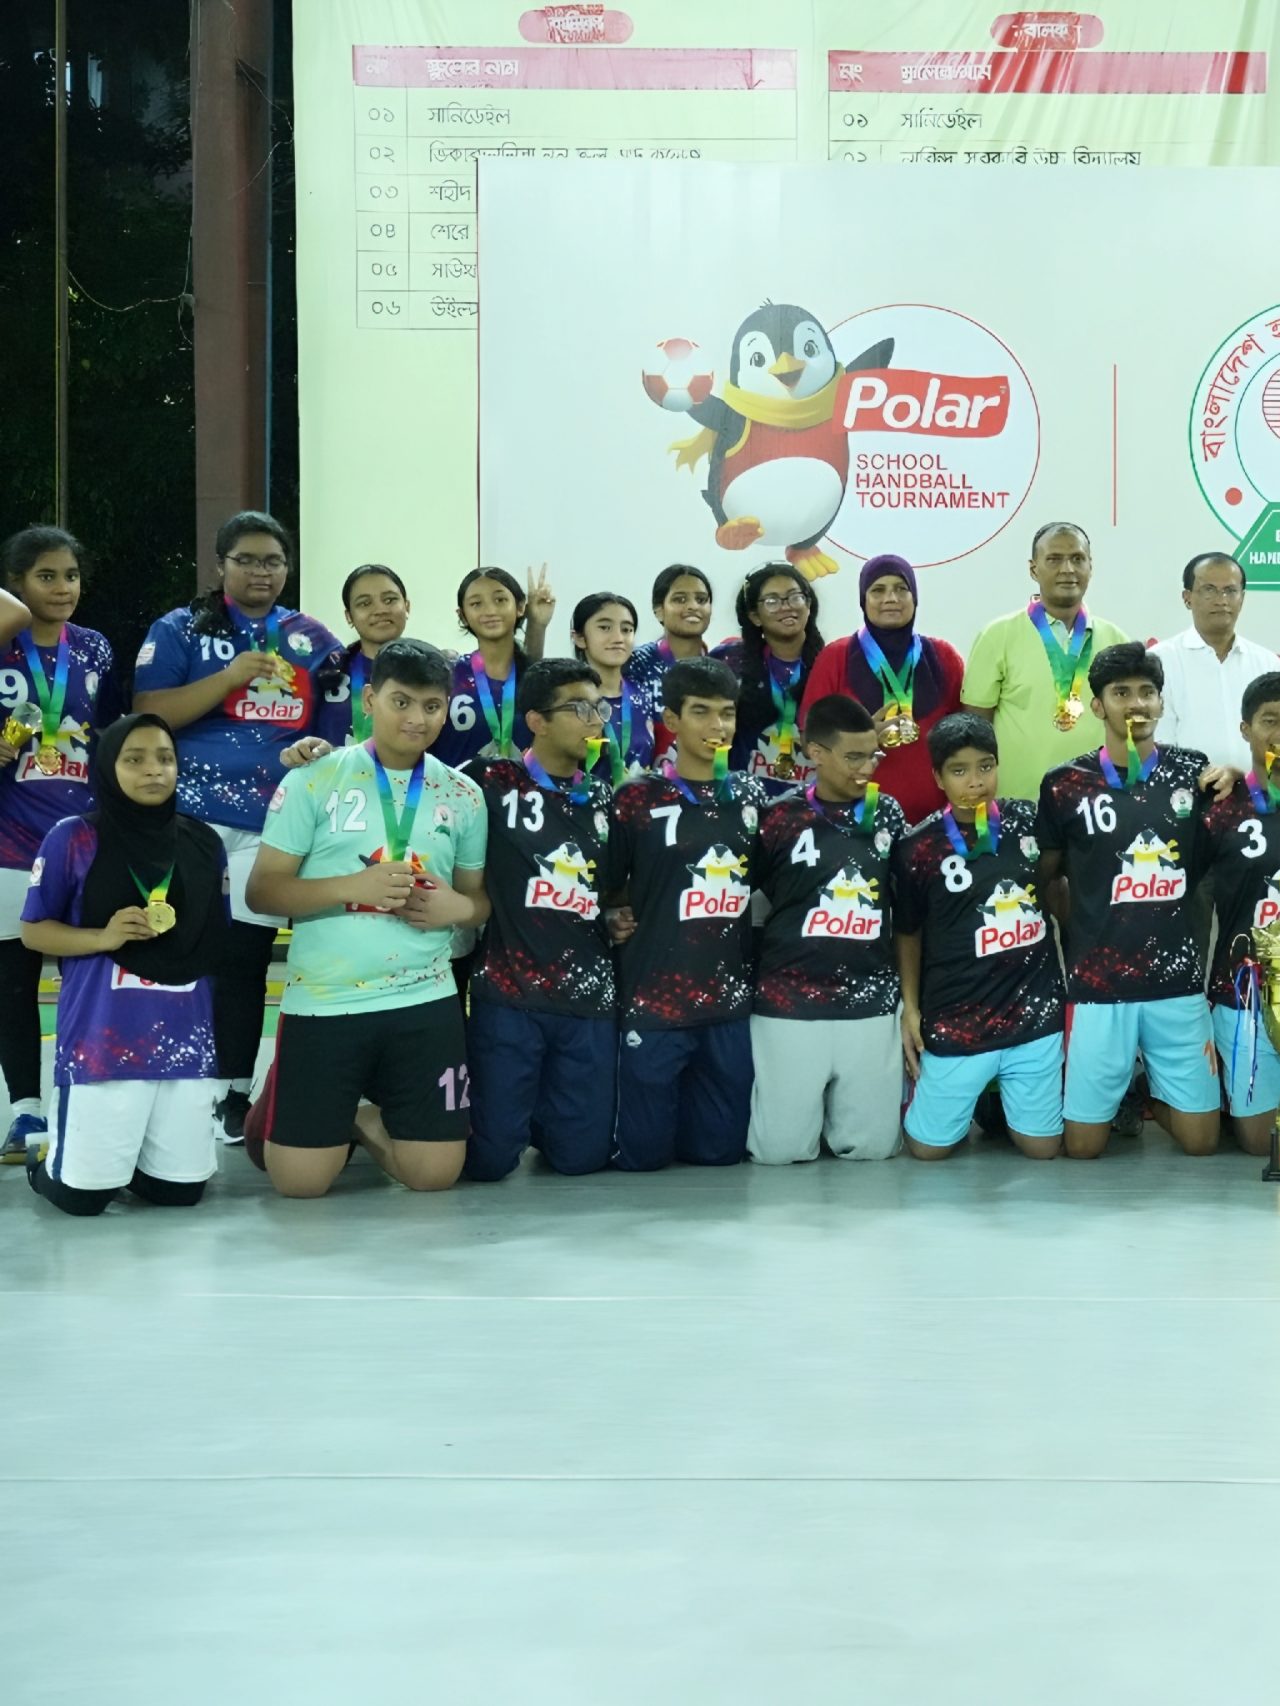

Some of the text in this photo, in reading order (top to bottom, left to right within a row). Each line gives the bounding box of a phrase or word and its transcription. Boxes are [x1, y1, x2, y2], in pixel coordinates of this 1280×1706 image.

[843, 376, 1001, 429] Polar
[1200, 334, 1266, 463] বাংলাদেশ
[855, 473, 973, 490] HANDBALL
[856, 453, 948, 471] SCHOOL
[855, 491, 1011, 509] TOURNAMENT
[240, 700, 302, 719] Polar
[325, 788, 367, 833] 12
[502, 789, 545, 832] 13
[650, 804, 683, 847] 7
[1076, 794, 1117, 835] 16
[791, 827, 820, 867] 4
[1238, 818, 1267, 858] 3
[940, 854, 973, 893] 8
[1113, 873, 1183, 902] Polar
[685, 888, 746, 917] Polar
[807, 909, 880, 935] Polar
[980, 918, 1044, 954] Polar
